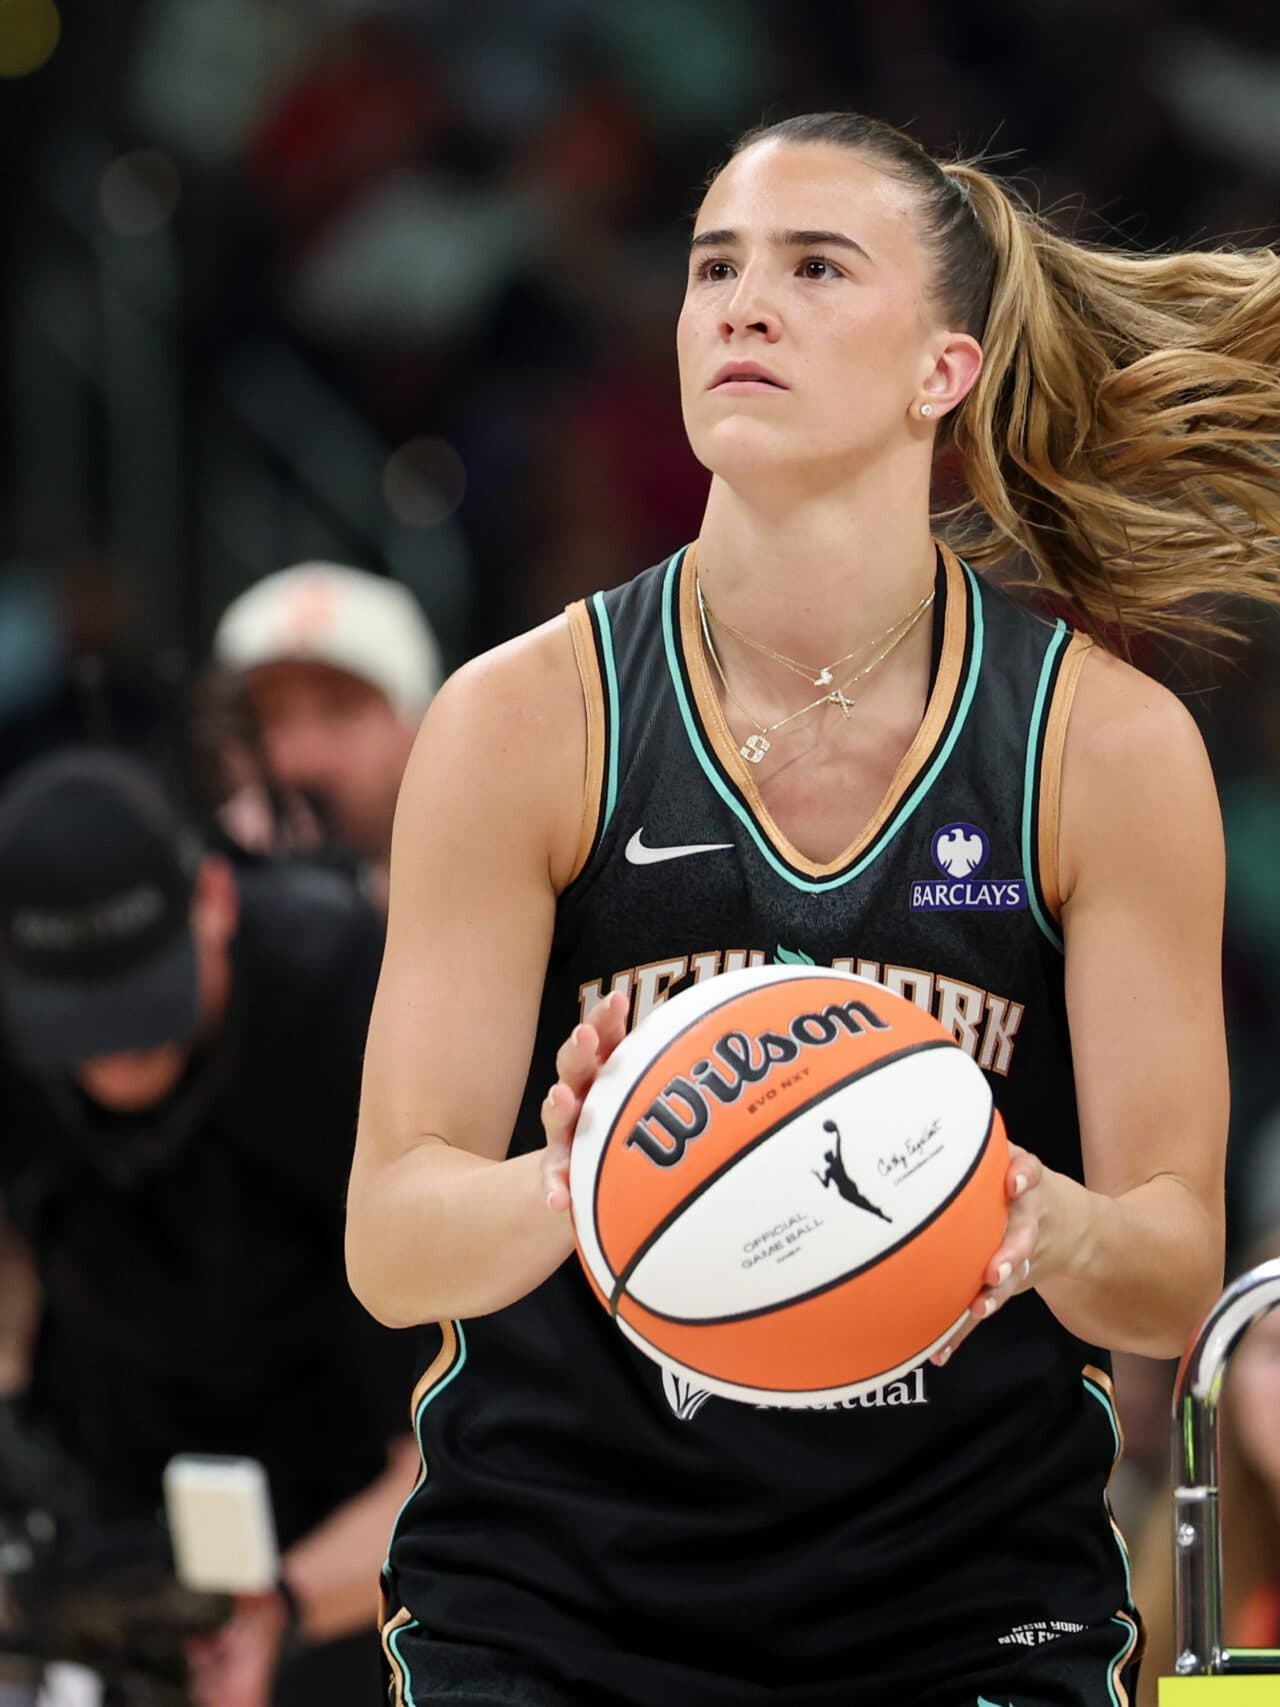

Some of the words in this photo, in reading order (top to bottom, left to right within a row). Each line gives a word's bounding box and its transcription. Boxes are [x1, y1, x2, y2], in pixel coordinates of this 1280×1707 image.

[912, 883, 1021, 907] BARCLAYS
[832, 957, 1026, 1078] ORK
[624, 999, 892, 1169] Wilson
[747, 1088, 777, 1115] EVO
[741, 1239, 785, 1269] GAME
[785, 1218, 825, 1244] BALL
[743, 1212, 808, 1253] OFFICIAL
[997, 1630, 1036, 1647] NIKE
